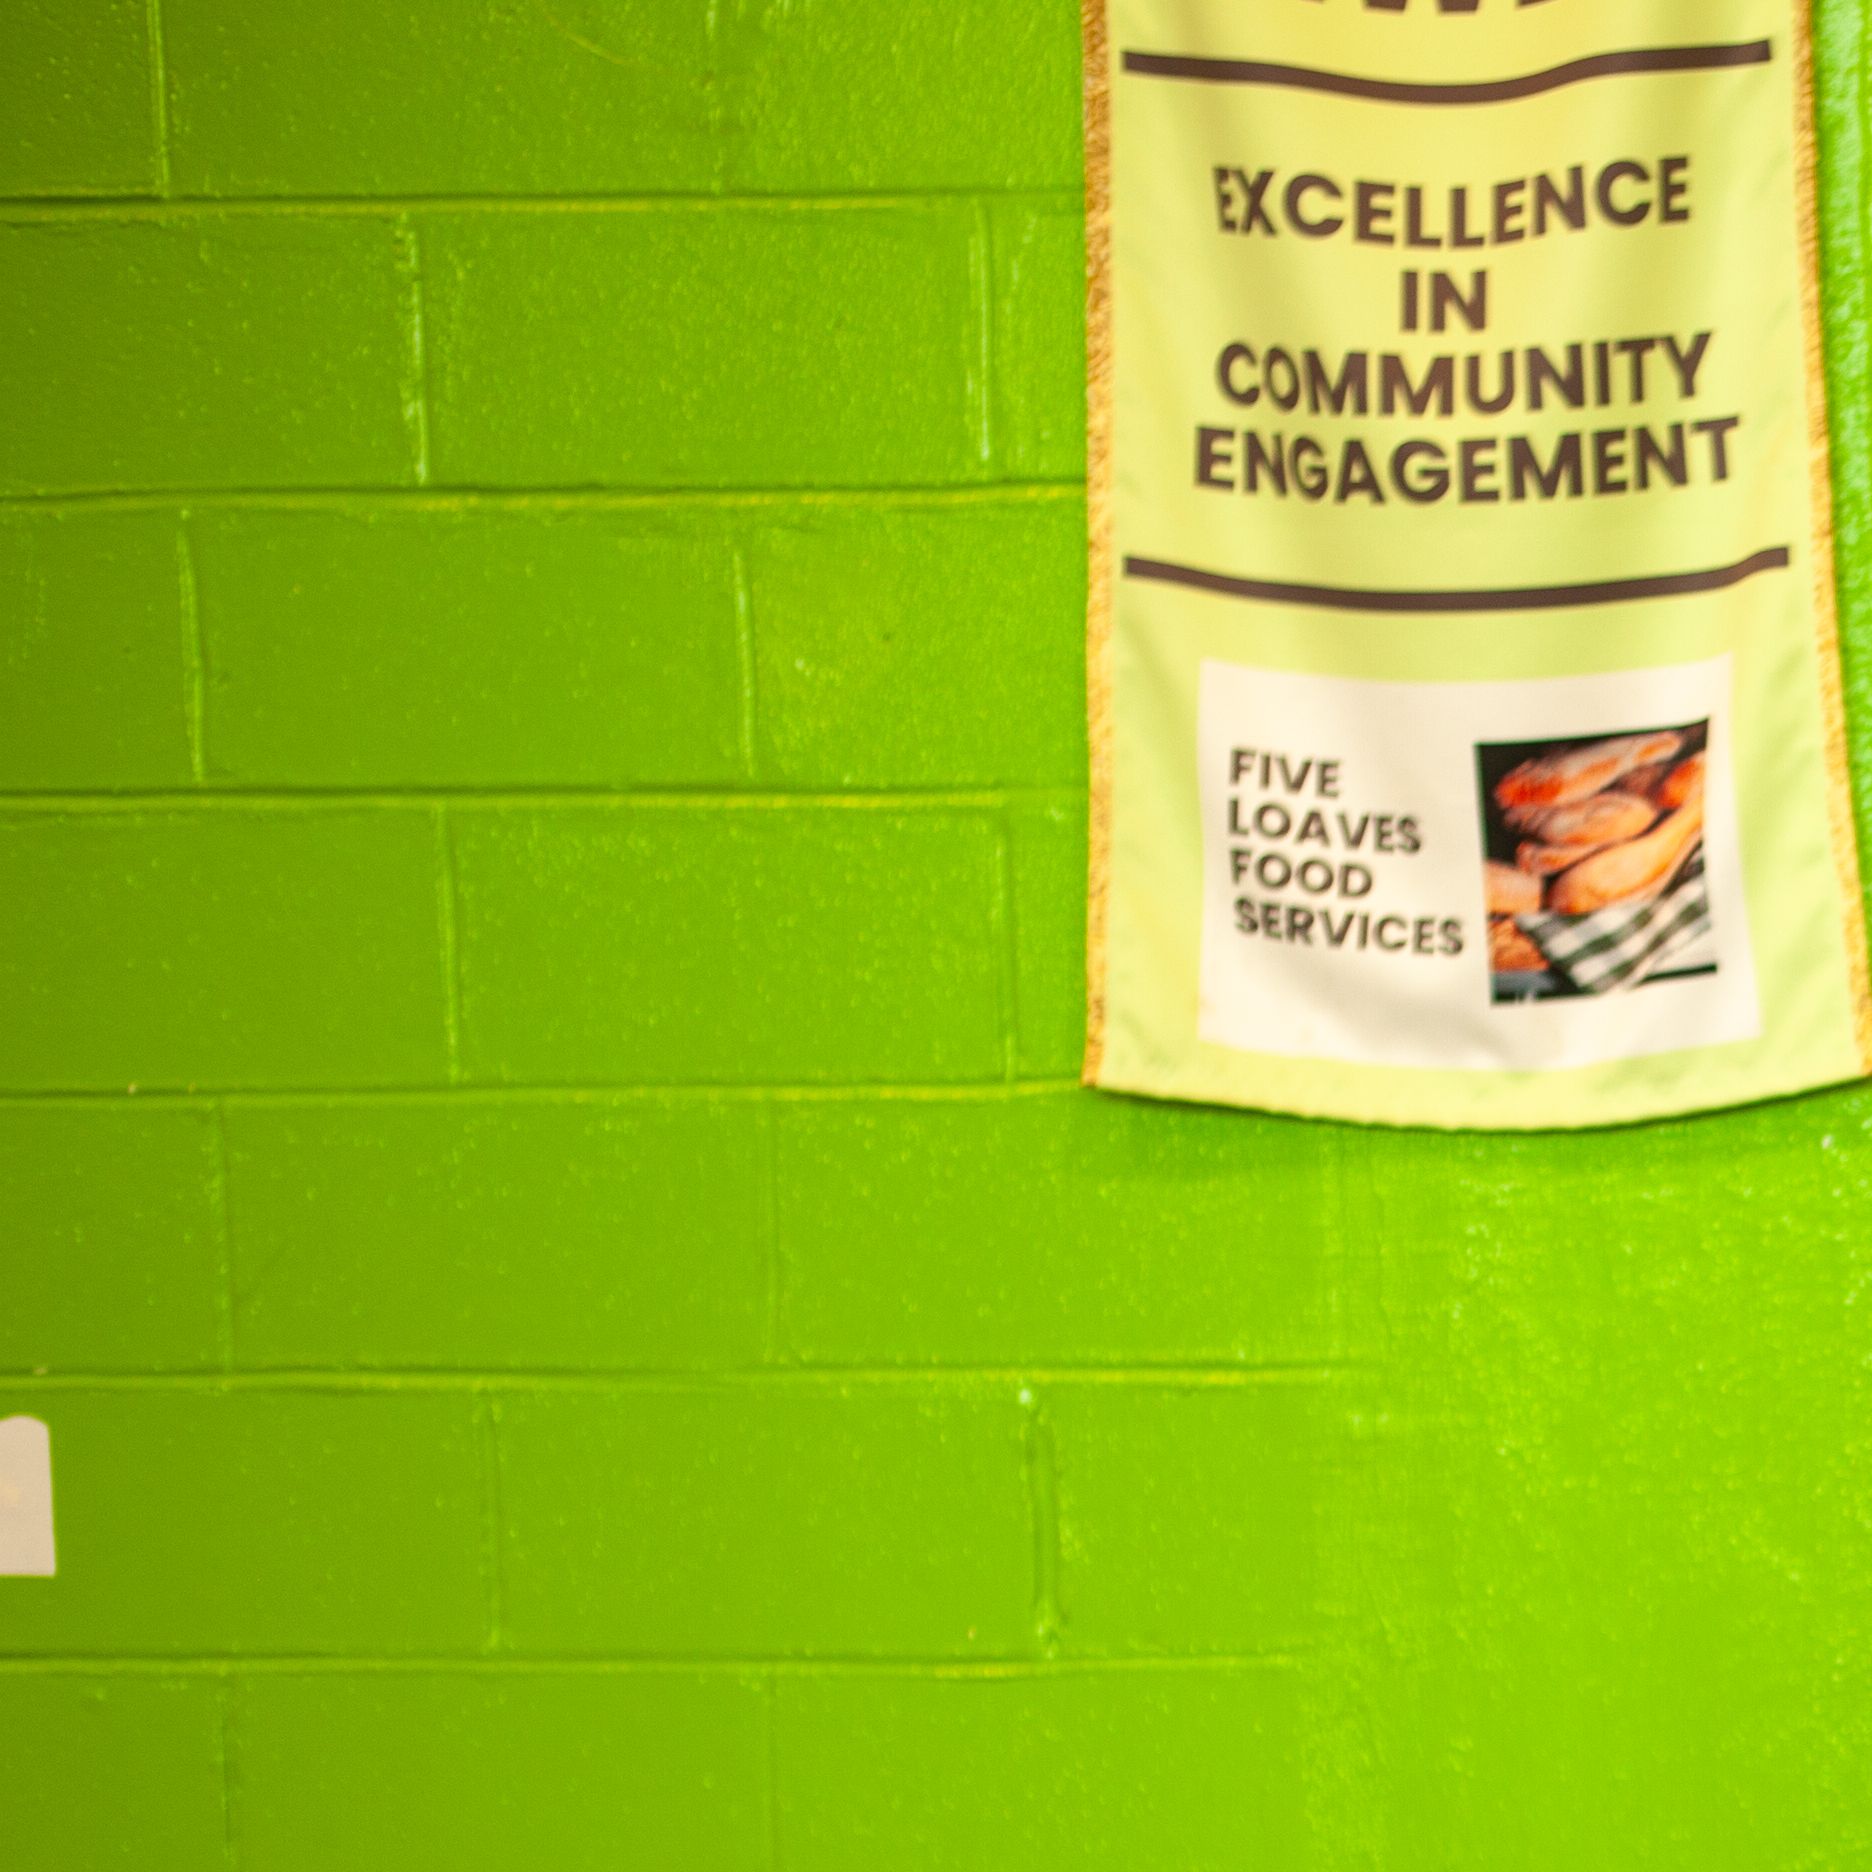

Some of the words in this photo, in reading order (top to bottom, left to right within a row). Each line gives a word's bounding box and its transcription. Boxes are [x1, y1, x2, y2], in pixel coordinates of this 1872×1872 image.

[1214, 156, 1690, 248] EXCELLENCE
[1401, 269, 1488, 332] IN
[1217, 330, 1713, 417] COMMUNITY
[1195, 416, 1741, 504] ENGAGEMENT
[1229, 748, 1340, 797] FIVE
[1228, 797, 1422, 854] LOAVES
[1229, 849, 1374, 898] FOOD
[1234, 897, 1464, 955] SERVICES
